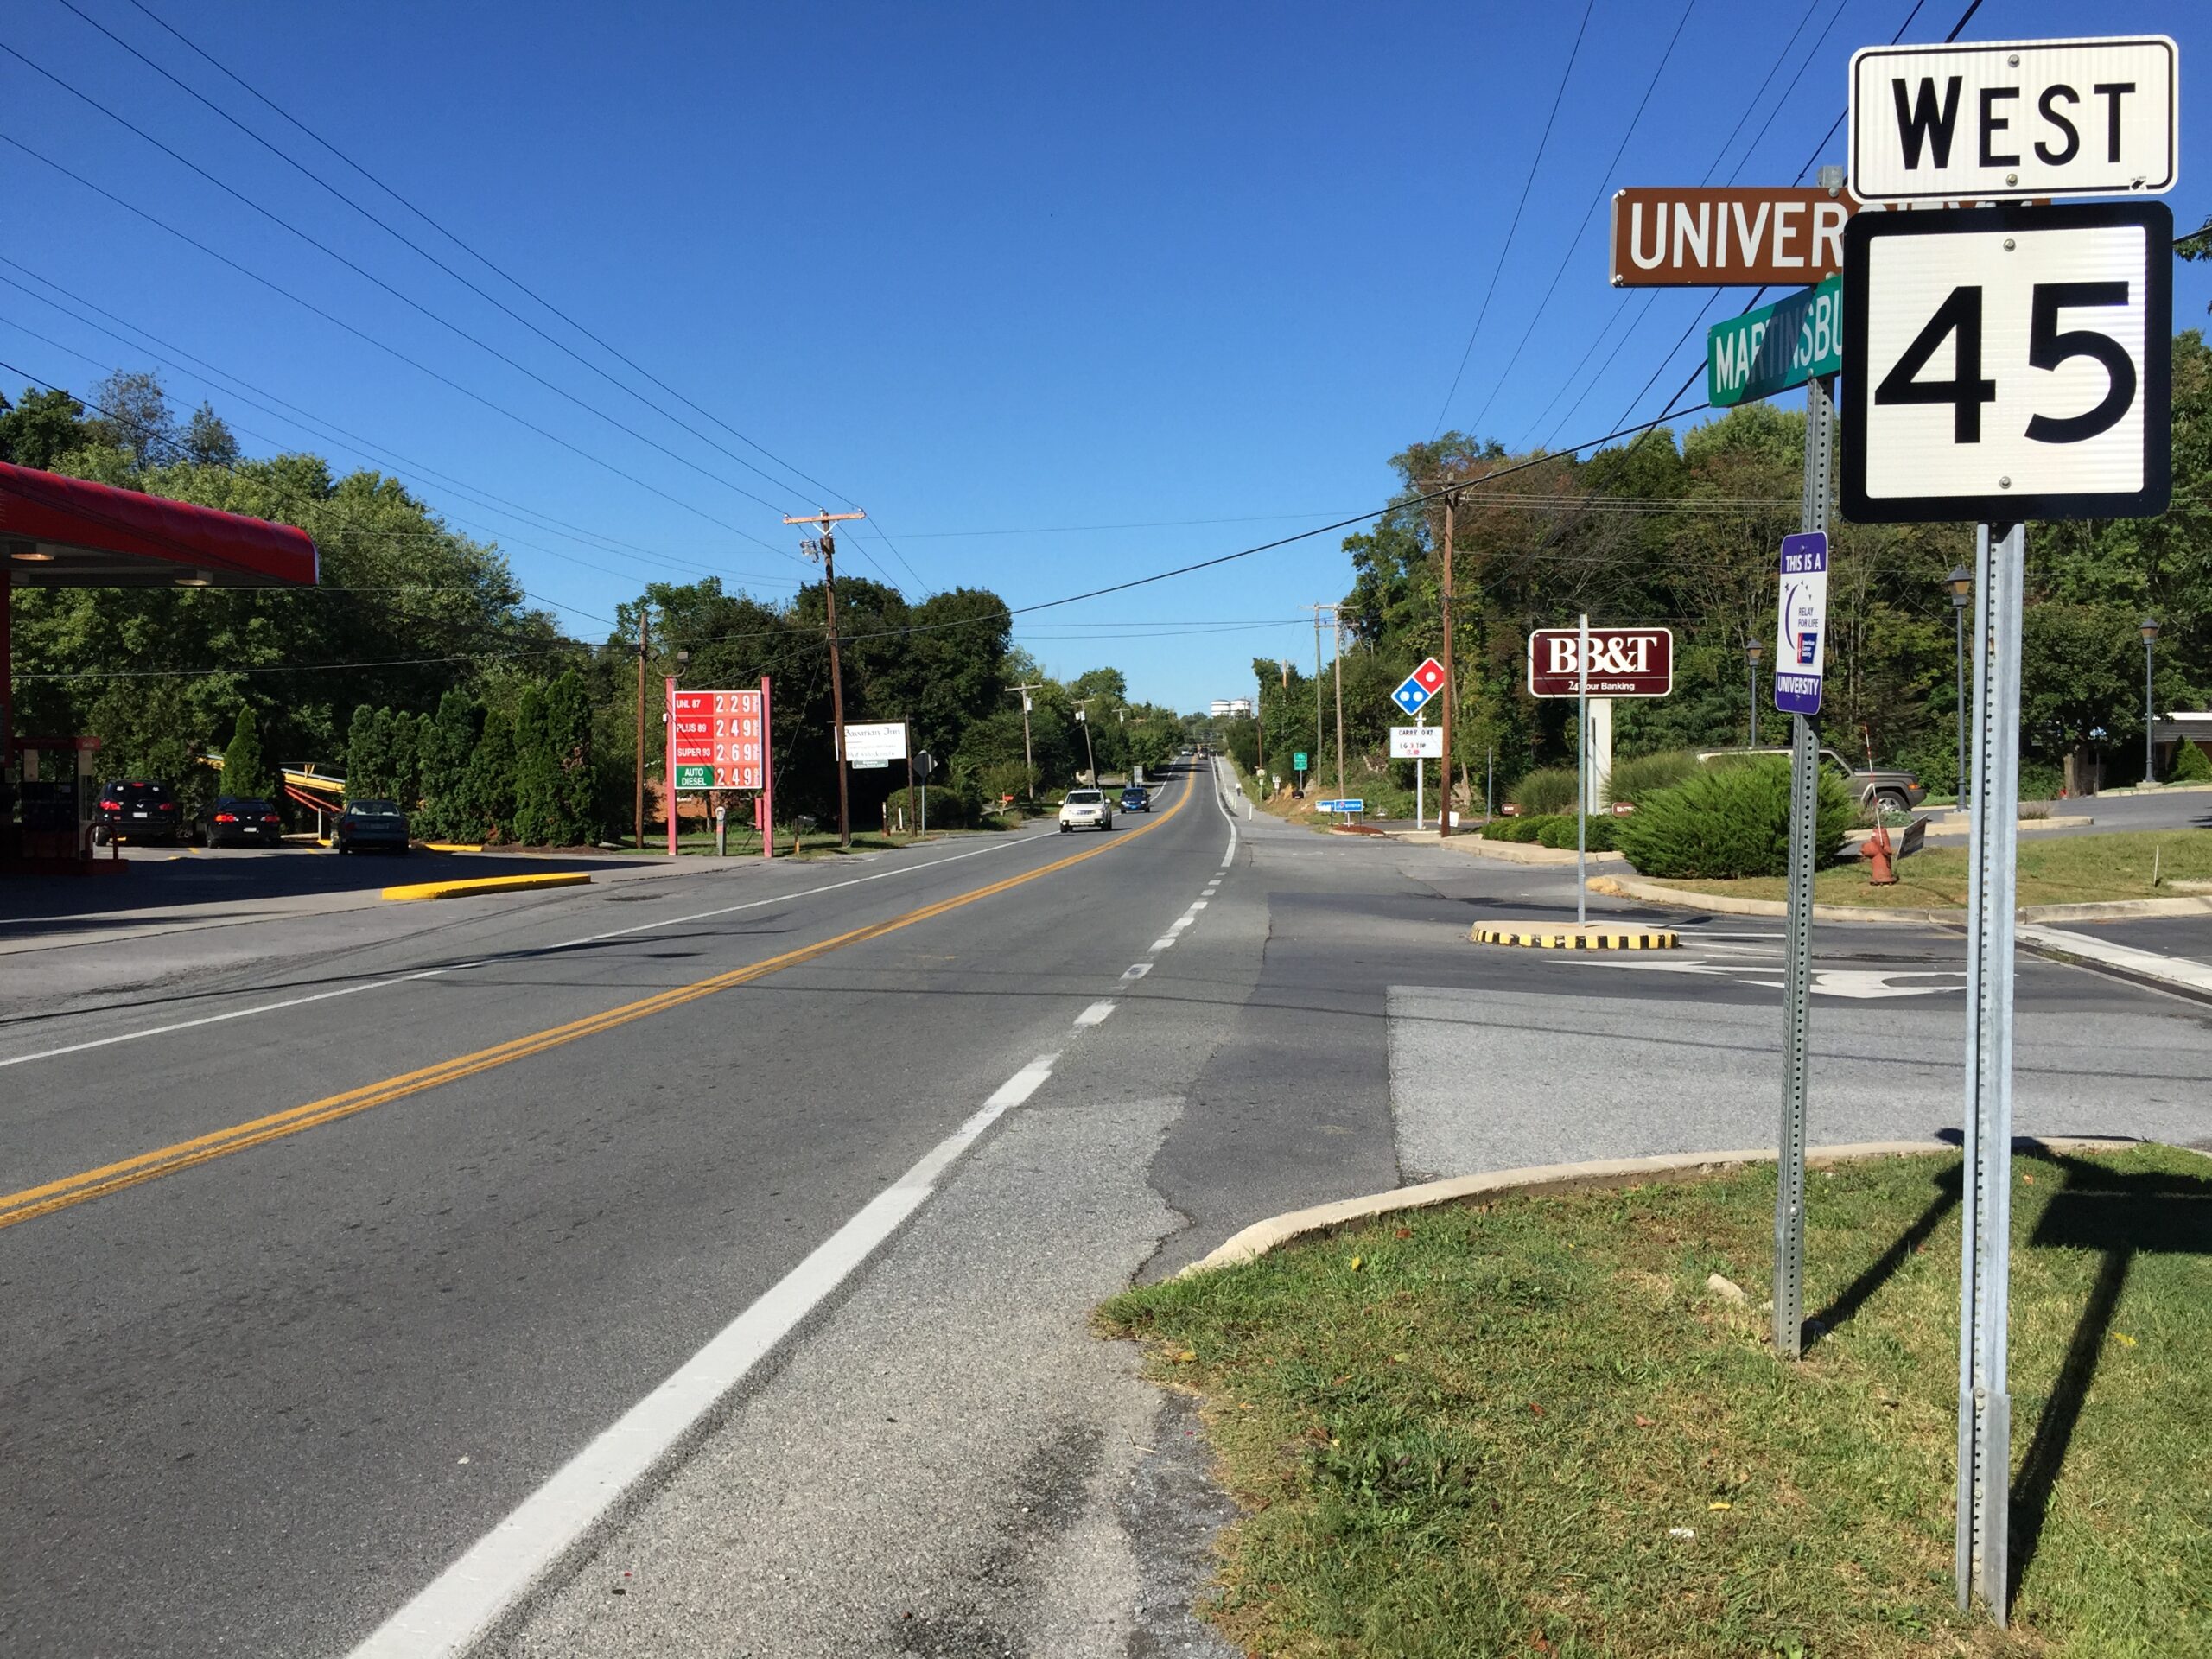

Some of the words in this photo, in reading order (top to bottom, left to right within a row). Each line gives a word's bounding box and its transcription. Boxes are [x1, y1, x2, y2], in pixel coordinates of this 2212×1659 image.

[1891, 75, 2136, 170] WEST
[1715, 289, 1843, 394] MARTINSBU
[1874, 280, 2138, 444] 45
[1785, 555, 1802, 572] THIS
[1804, 553, 1812, 570] IS
[1814, 552, 1821, 570] A
[1798, 607, 1814, 616] RELAY
[1797, 619, 1808, 627] FOR
[1808, 618, 1819, 627] LIFE
[1546, 637, 1657, 674] BB&T
[1600, 681, 1635, 691] Banking
[1777, 676, 1819, 696] UNIVERSITY
[677, 699, 691, 709] UNL
[691, 699, 701, 709] 87
[677, 723, 696, 733] PLUS
[697, 723, 707, 733] 89
[677, 747, 702, 757] SUPER
[702, 747, 711, 757] 93
[684, 767, 704, 777] AUTO
[681, 777, 707, 786] DIESEL
